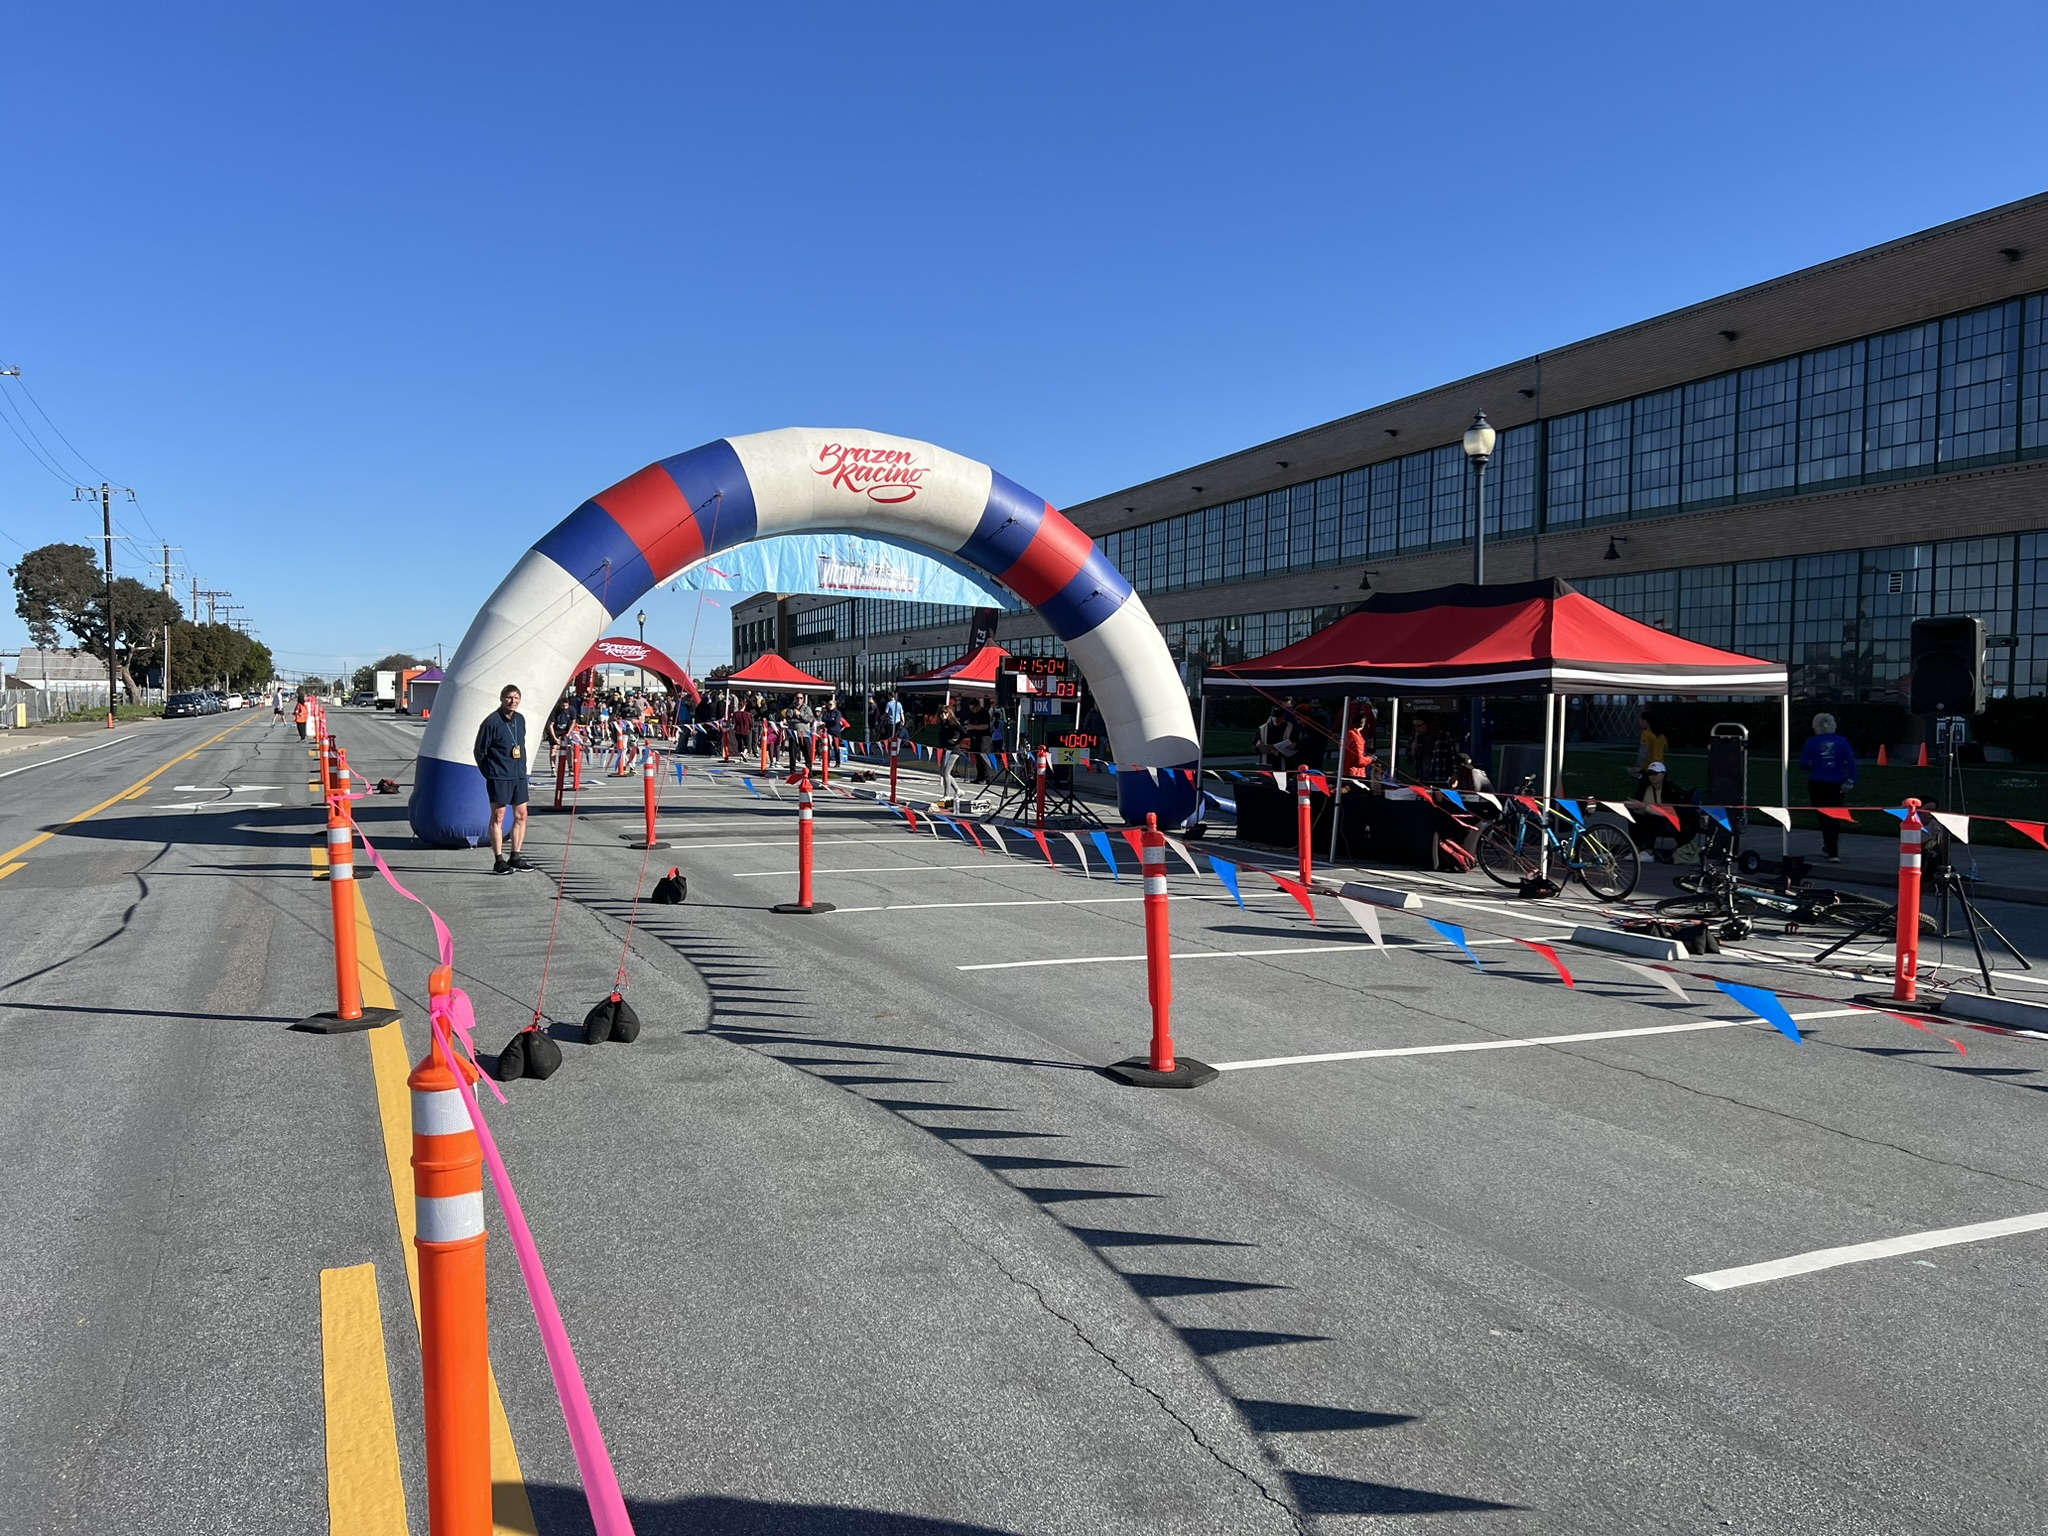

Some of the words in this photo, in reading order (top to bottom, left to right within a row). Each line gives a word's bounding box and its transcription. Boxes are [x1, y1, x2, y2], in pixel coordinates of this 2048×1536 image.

[810, 443, 918, 476] Brazen
[832, 463, 931, 504] Racing
[605, 648, 651, 661] Racing
[1029, 678, 1045, 689] HALF
[1033, 700, 1048, 712] 10K
[1060, 734, 1097, 748] 40:04
[1063, 751, 1074, 762] 5K
